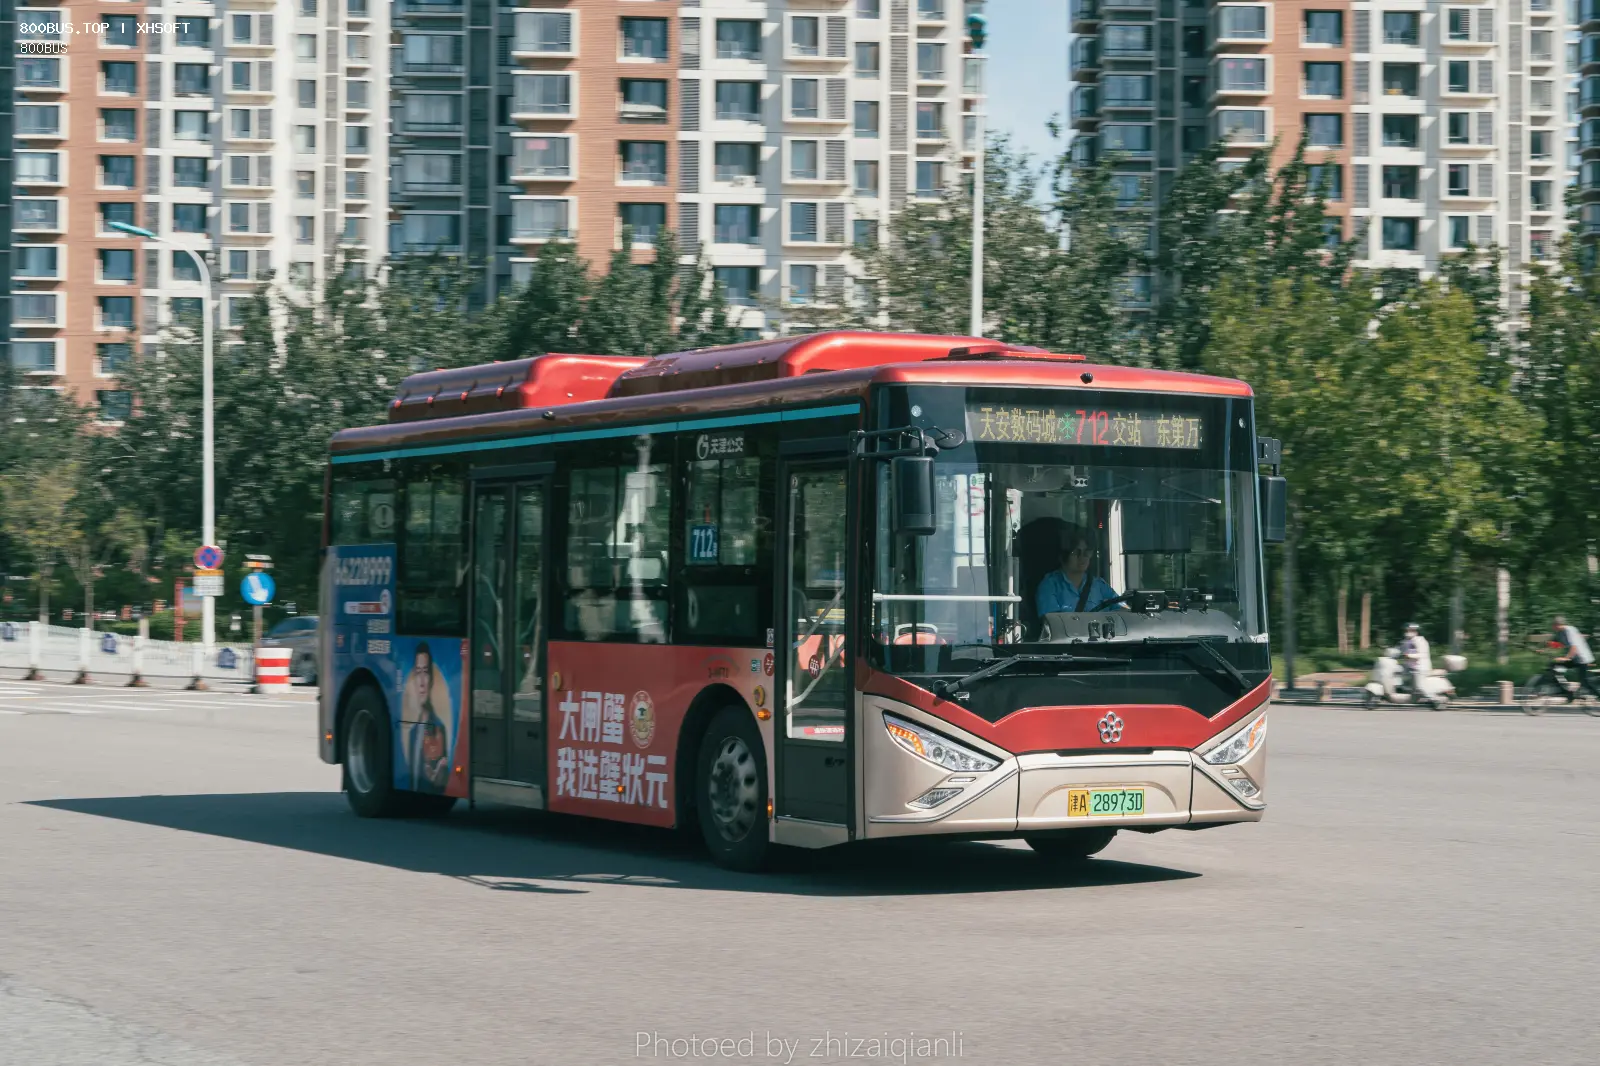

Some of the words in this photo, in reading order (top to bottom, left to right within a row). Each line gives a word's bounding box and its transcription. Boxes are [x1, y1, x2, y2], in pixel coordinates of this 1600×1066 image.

[980, 407, 1062, 442] 天安数码城
[1076, 410, 1109, 444] 712
[1157, 413, 1203, 448] 东第万
[693, 528, 714, 558] 712
[559, 690, 625, 744] 大闸蟹
[557, 746, 668, 809] 我选蟹状元
